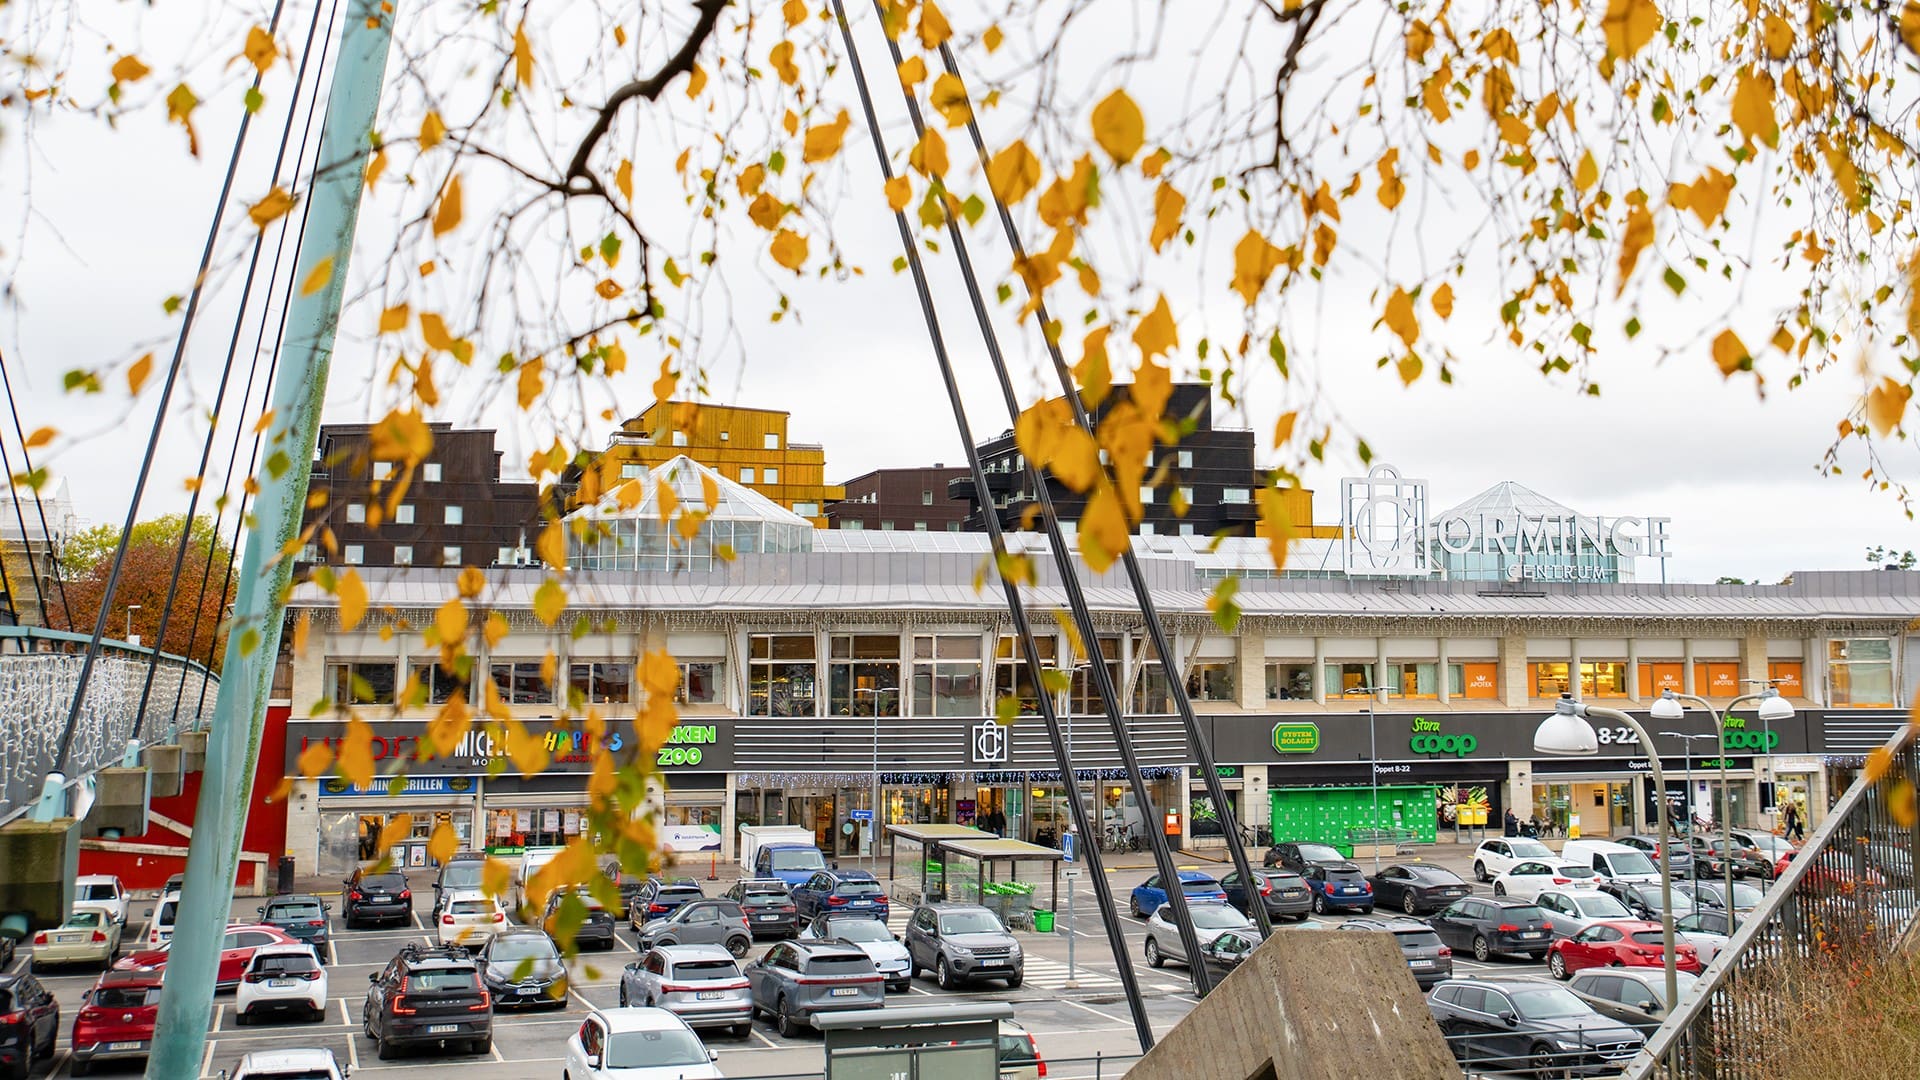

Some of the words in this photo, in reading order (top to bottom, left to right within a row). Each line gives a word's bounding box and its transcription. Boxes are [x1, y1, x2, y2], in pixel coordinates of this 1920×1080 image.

[1437, 511, 1673, 559] ORMINGE
[1506, 563, 1607, 580] CENTRUM
[1411, 716, 1441, 733] Stora
[1410, 733, 1478, 758] coop
[657, 747, 702, 765] ZOO
[1374, 764, 1395, 774] Öppet
[1395, 765, 1411, 773] 8-22
[1628, 760, 1649, 770] Öppet
